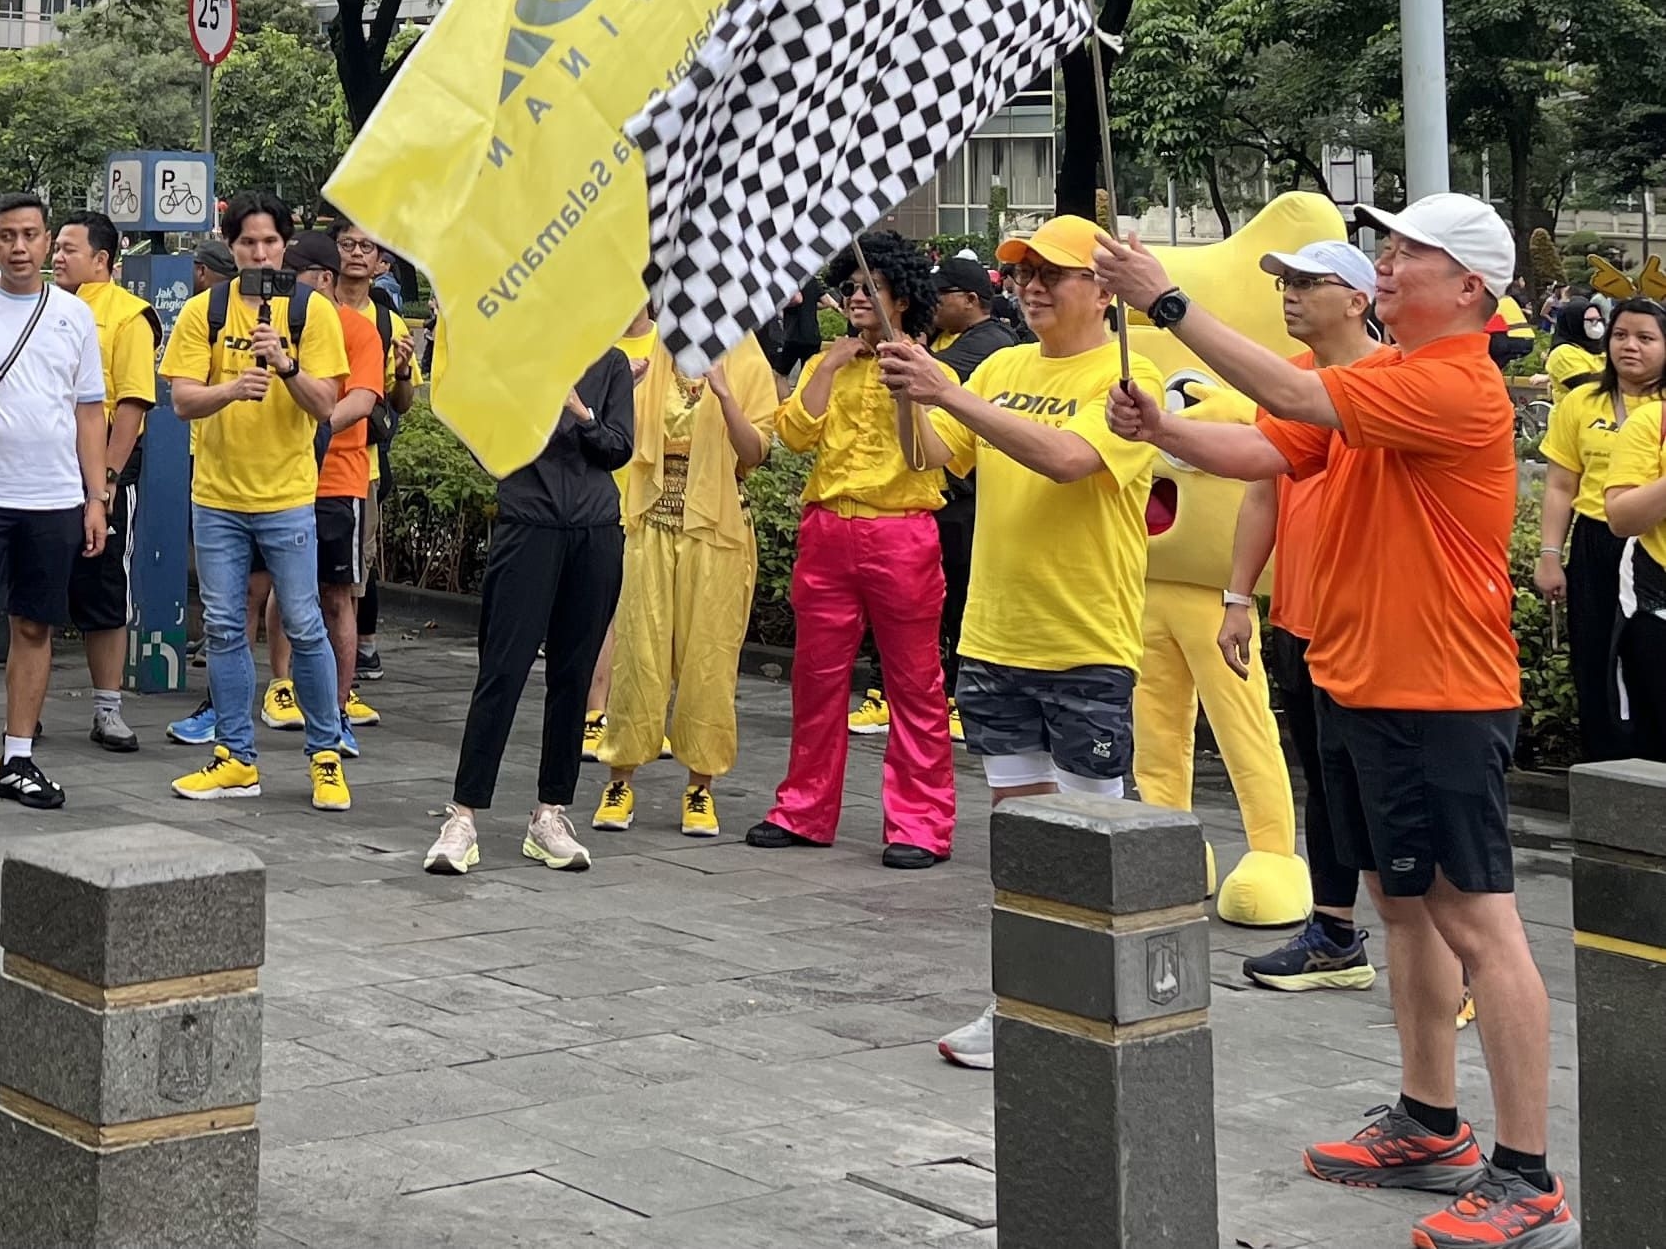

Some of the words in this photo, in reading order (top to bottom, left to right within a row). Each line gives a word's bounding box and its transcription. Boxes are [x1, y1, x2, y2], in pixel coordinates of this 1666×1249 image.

[111, 169, 122, 191] P
[162, 169, 176, 191] P
[155, 287, 173, 299] Jak
[989, 391, 1077, 417] ADIRA
